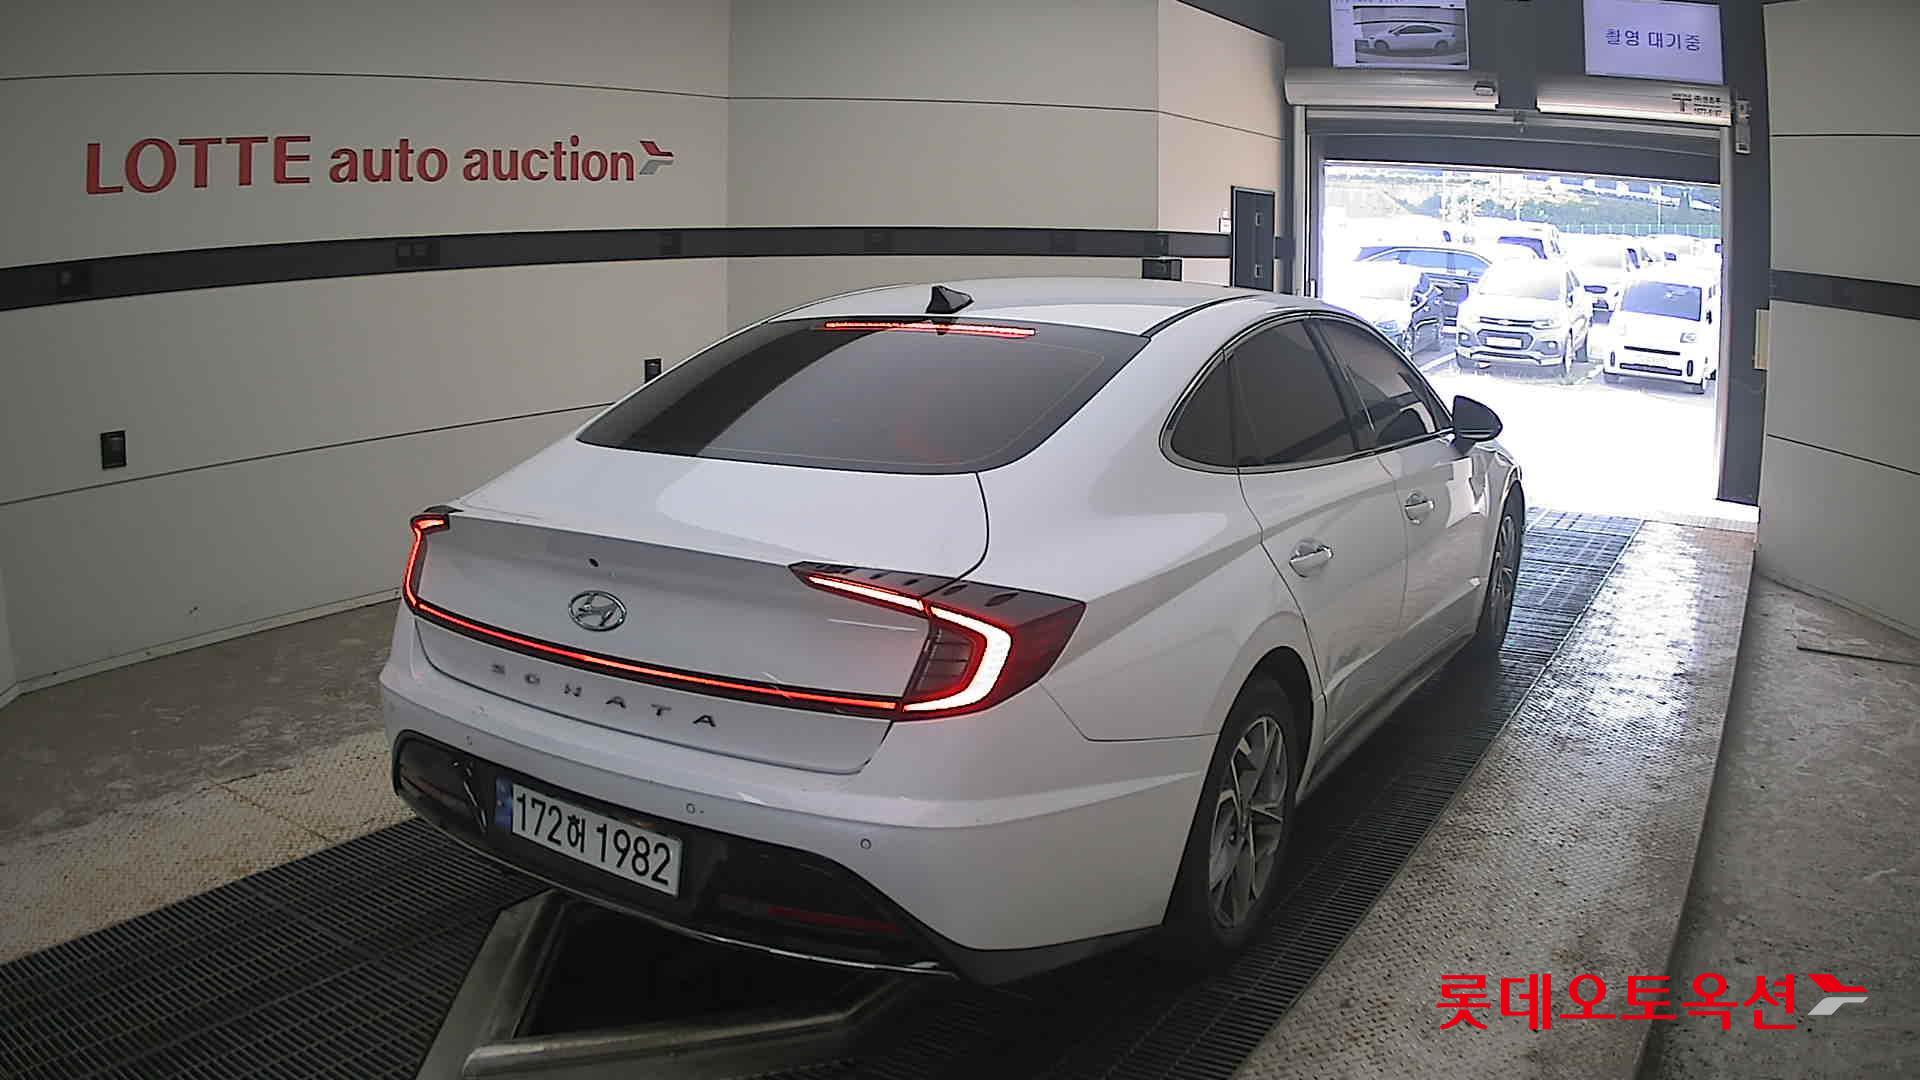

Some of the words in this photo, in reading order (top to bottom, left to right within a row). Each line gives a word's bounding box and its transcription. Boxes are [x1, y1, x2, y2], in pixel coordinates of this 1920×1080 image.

[1648, 31, 1701, 52] 대기중
[86, 135, 311, 195] LOTTE
[329, 138, 449, 183] auto
[462, 135, 636, 182] auction
[491, 662, 718, 729] SONATA
